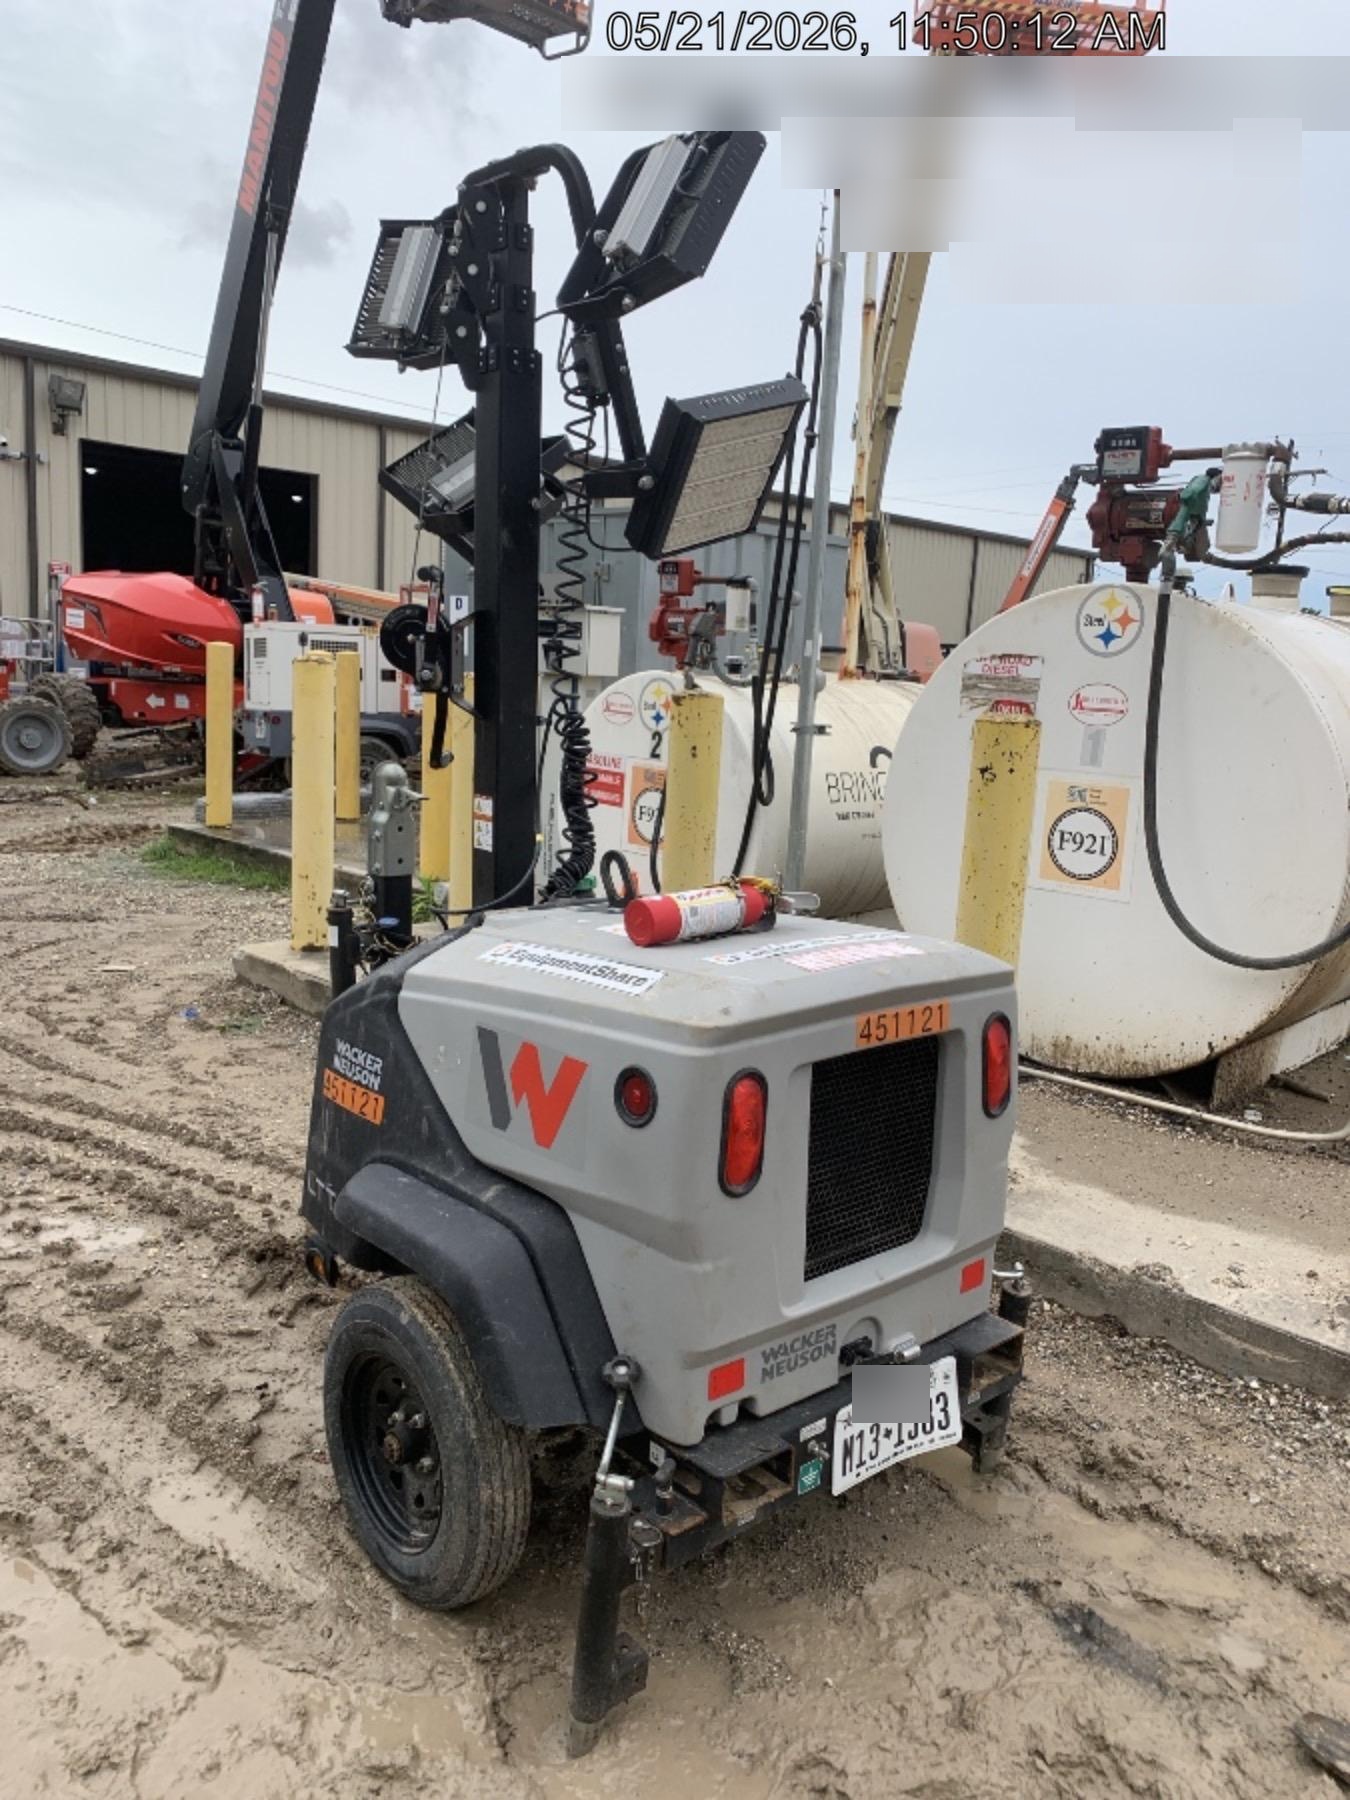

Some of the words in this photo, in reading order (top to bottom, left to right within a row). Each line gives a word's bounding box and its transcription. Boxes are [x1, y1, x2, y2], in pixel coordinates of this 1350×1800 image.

[239, 27, 287, 216] MANITOU
[586, 754, 622, 770] ASOLINE
[650, 731, 663, 759] 2
[511, 949, 649, 988] EquipmentShare
[859, 1003, 944, 1043] 451121
[333, 1054, 381, 1091] NEUSON
[336, 1038, 383, 1075] WACKER
[760, 1340, 837, 1385] NEUSON
[761, 1323, 837, 1365] WACKER
